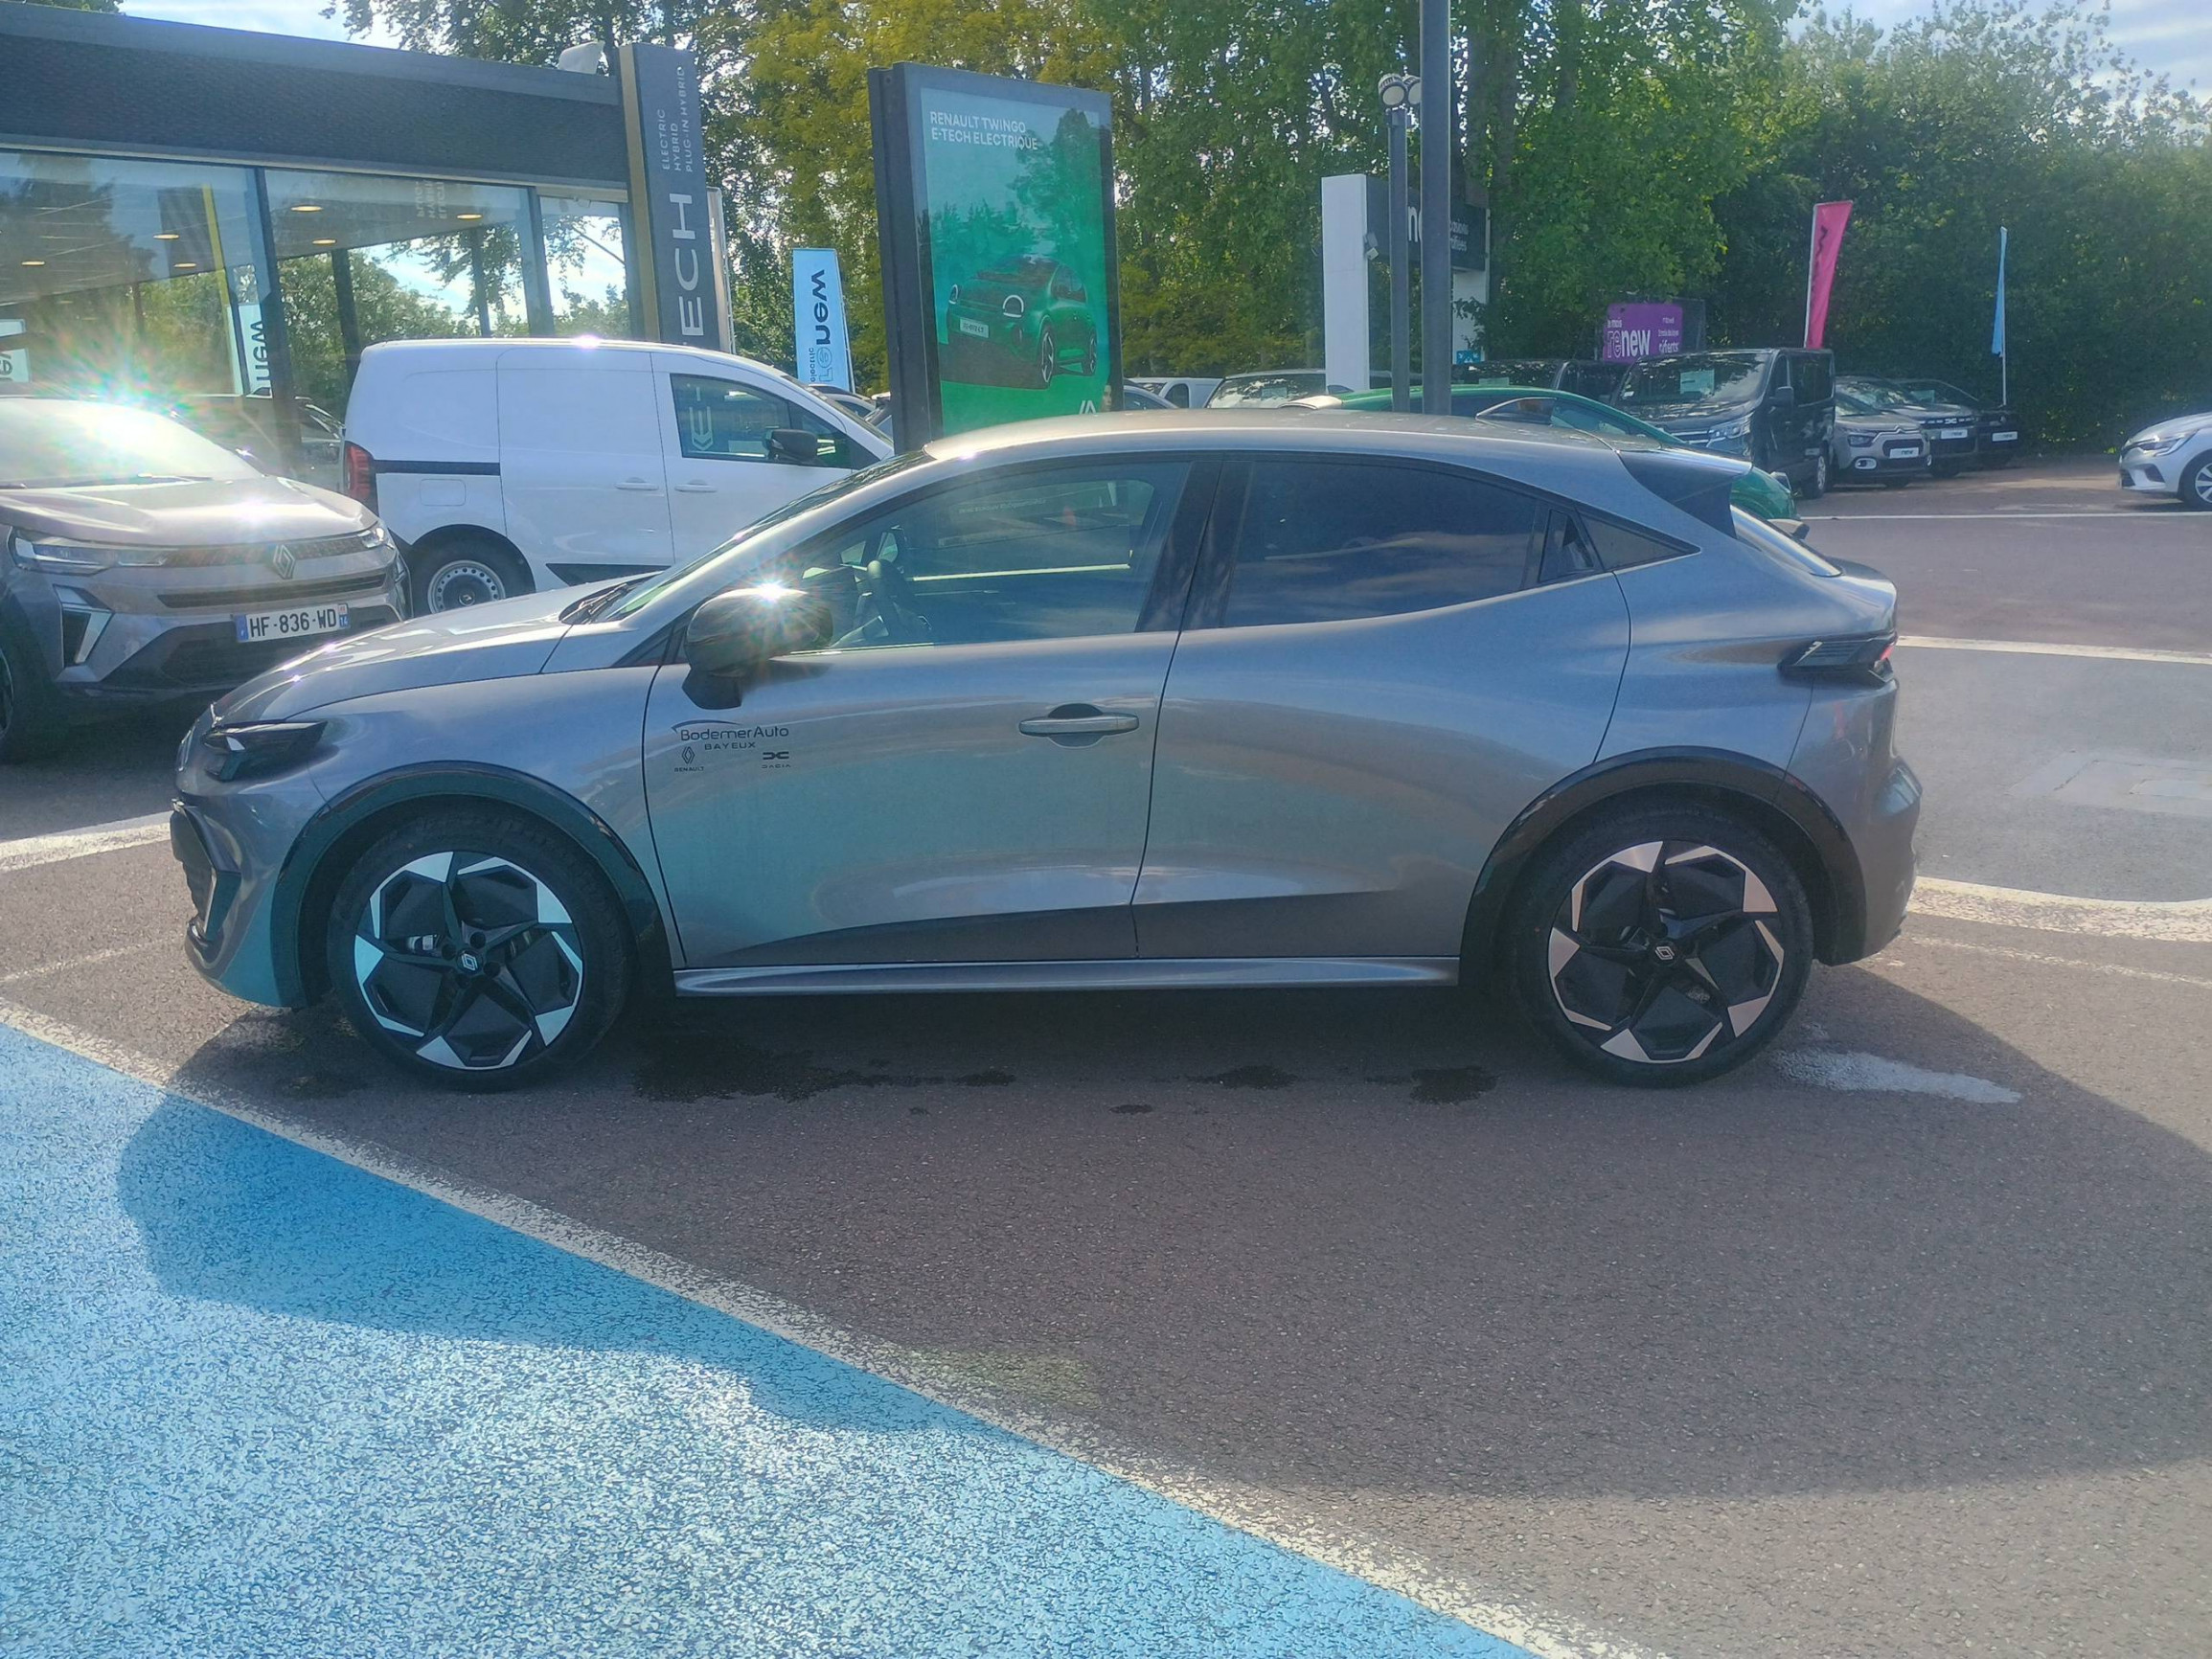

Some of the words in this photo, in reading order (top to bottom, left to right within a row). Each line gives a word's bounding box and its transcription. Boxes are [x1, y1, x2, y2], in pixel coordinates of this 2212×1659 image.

[677, 66, 688, 116] HYBRID
[657, 109, 670, 170] ELECTRIC
[681, 119, 693, 172] PLUG-IN
[930, 111, 979, 128] RENAULT
[981, 117, 1026, 133] TWINGO
[931, 127, 971, 144] E-TECH
[973, 132, 1038, 150] ELECTRIQUE
[671, 123, 681, 171] HYBRID
[670, 193, 704, 336] ECH
[249, 608, 337, 638] HF-836-WD
[704, 741, 756, 750] BAYEUX
